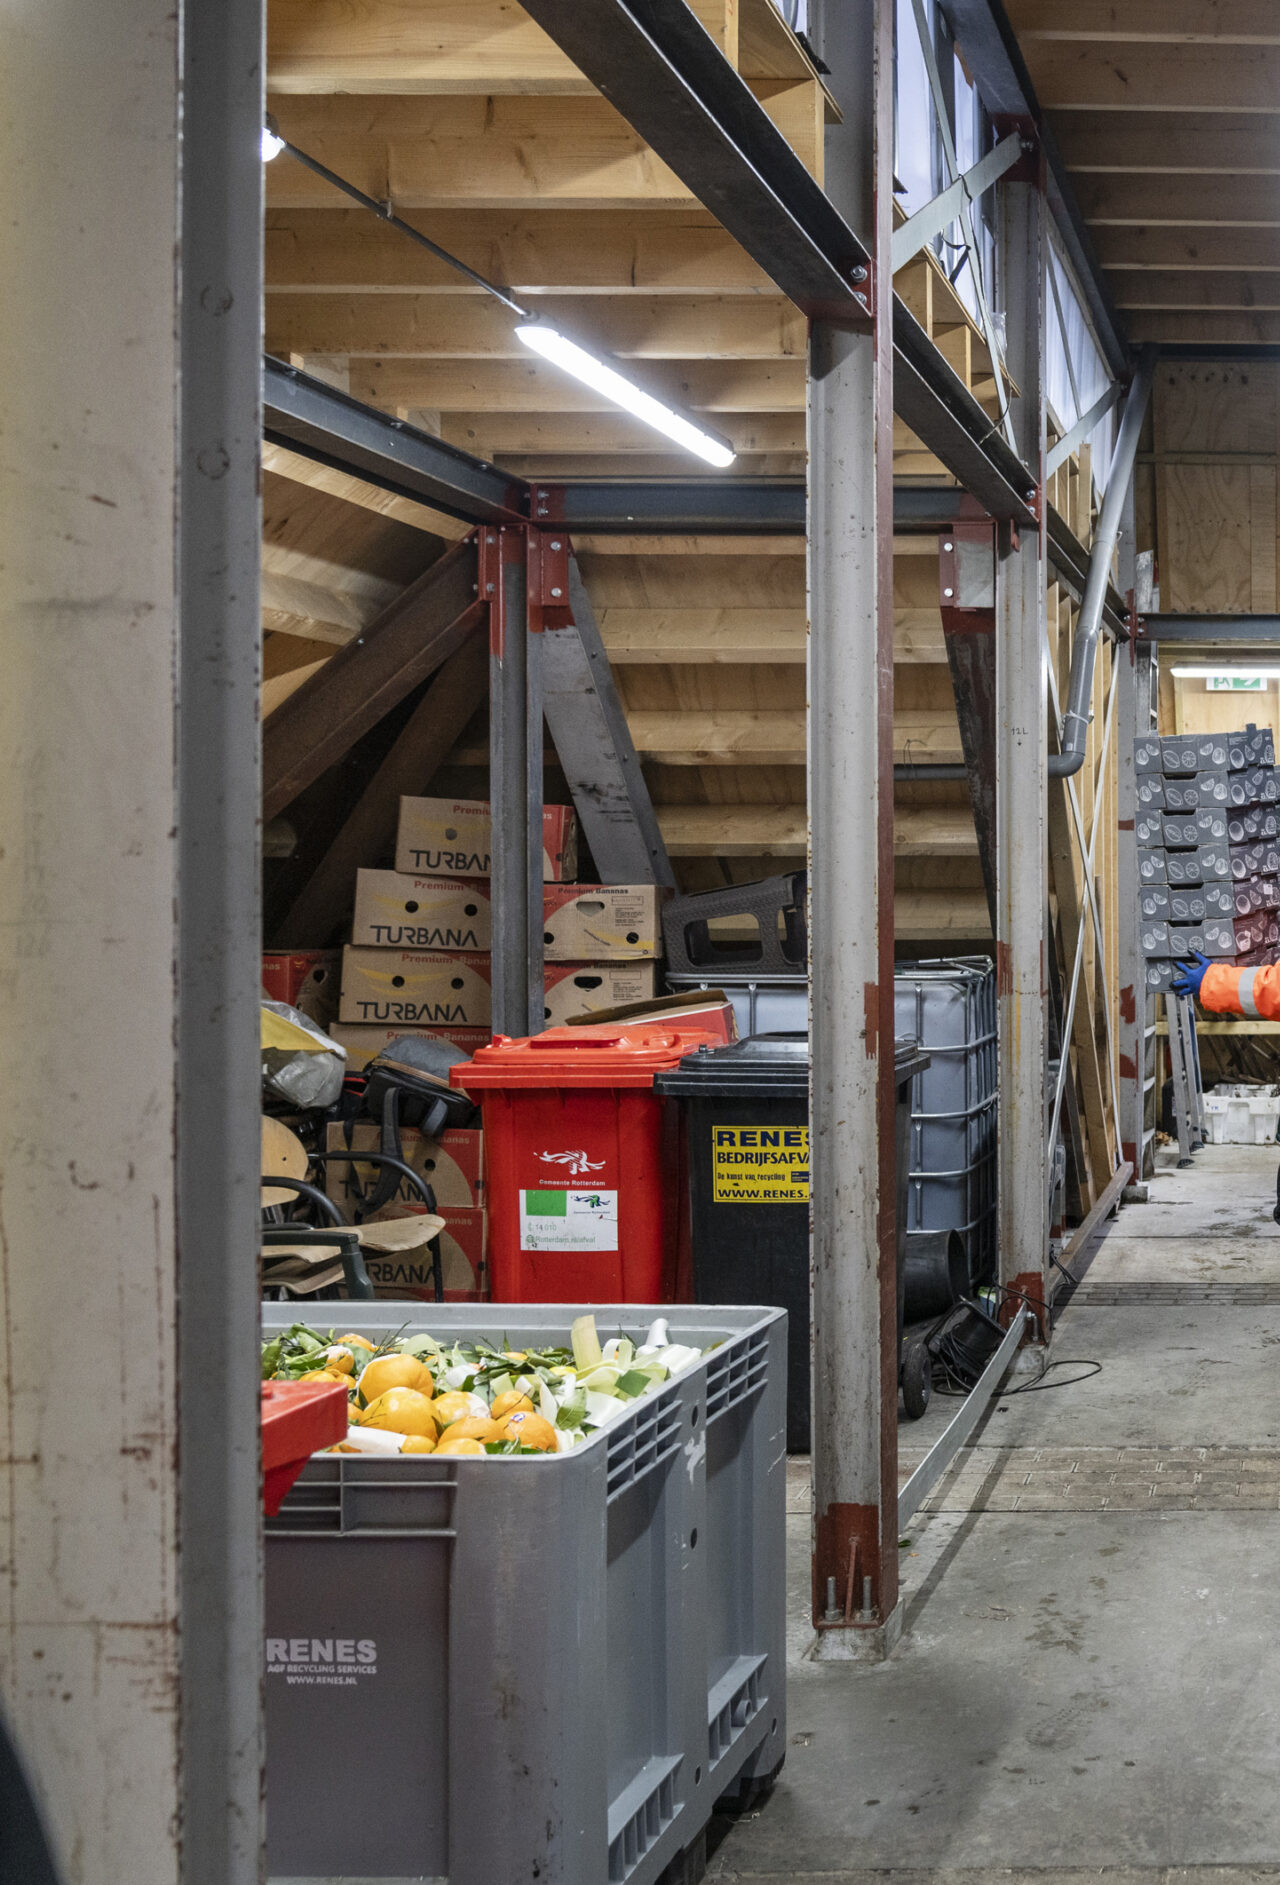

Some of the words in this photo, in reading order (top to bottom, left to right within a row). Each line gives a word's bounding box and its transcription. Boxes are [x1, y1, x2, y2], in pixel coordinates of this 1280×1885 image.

[414, 880, 464, 891] Premium
[370, 925, 478, 947] TURBANA
[402, 952, 453, 964] Premium
[356, 1001, 468, 1022] TURBANA
[717, 1172, 725, 1180] De
[757, 1172, 785, 1181] recycling
[266, 1638, 377, 1663] RENES
[267, 1664, 286, 1673] AGF
[287, 1664, 335, 1673] RECYCLING
[337, 1665, 377, 1674] SERVICES
[286, 1676, 358, 1685] WWW.RENES.NL
